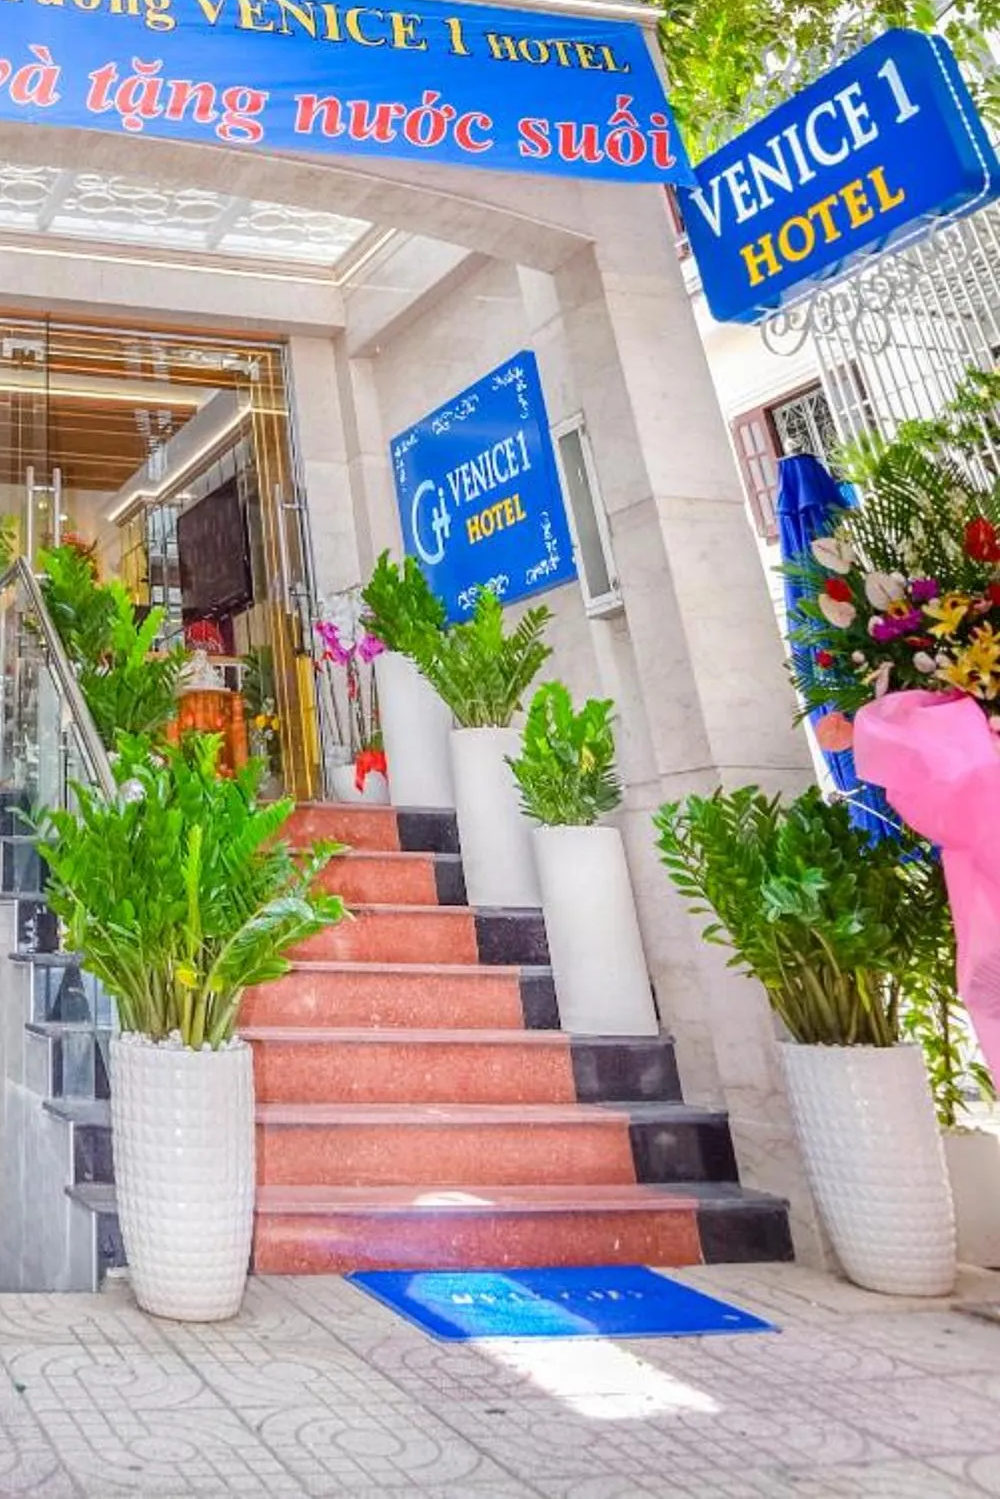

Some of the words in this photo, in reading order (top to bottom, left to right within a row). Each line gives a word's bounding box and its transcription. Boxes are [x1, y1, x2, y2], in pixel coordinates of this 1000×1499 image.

[443, 17, 470, 56] 1
[487, 32, 630, 75] HOTEL
[86, 55, 270, 144] tặng
[293, 89, 496, 153] nước
[517, 94, 676, 170] suối
[687, 81, 880, 238] VENICE
[877, 57, 921, 124] 1
[739, 165, 906, 288] HOTEL
[464, 493, 528, 545] HOTEL
